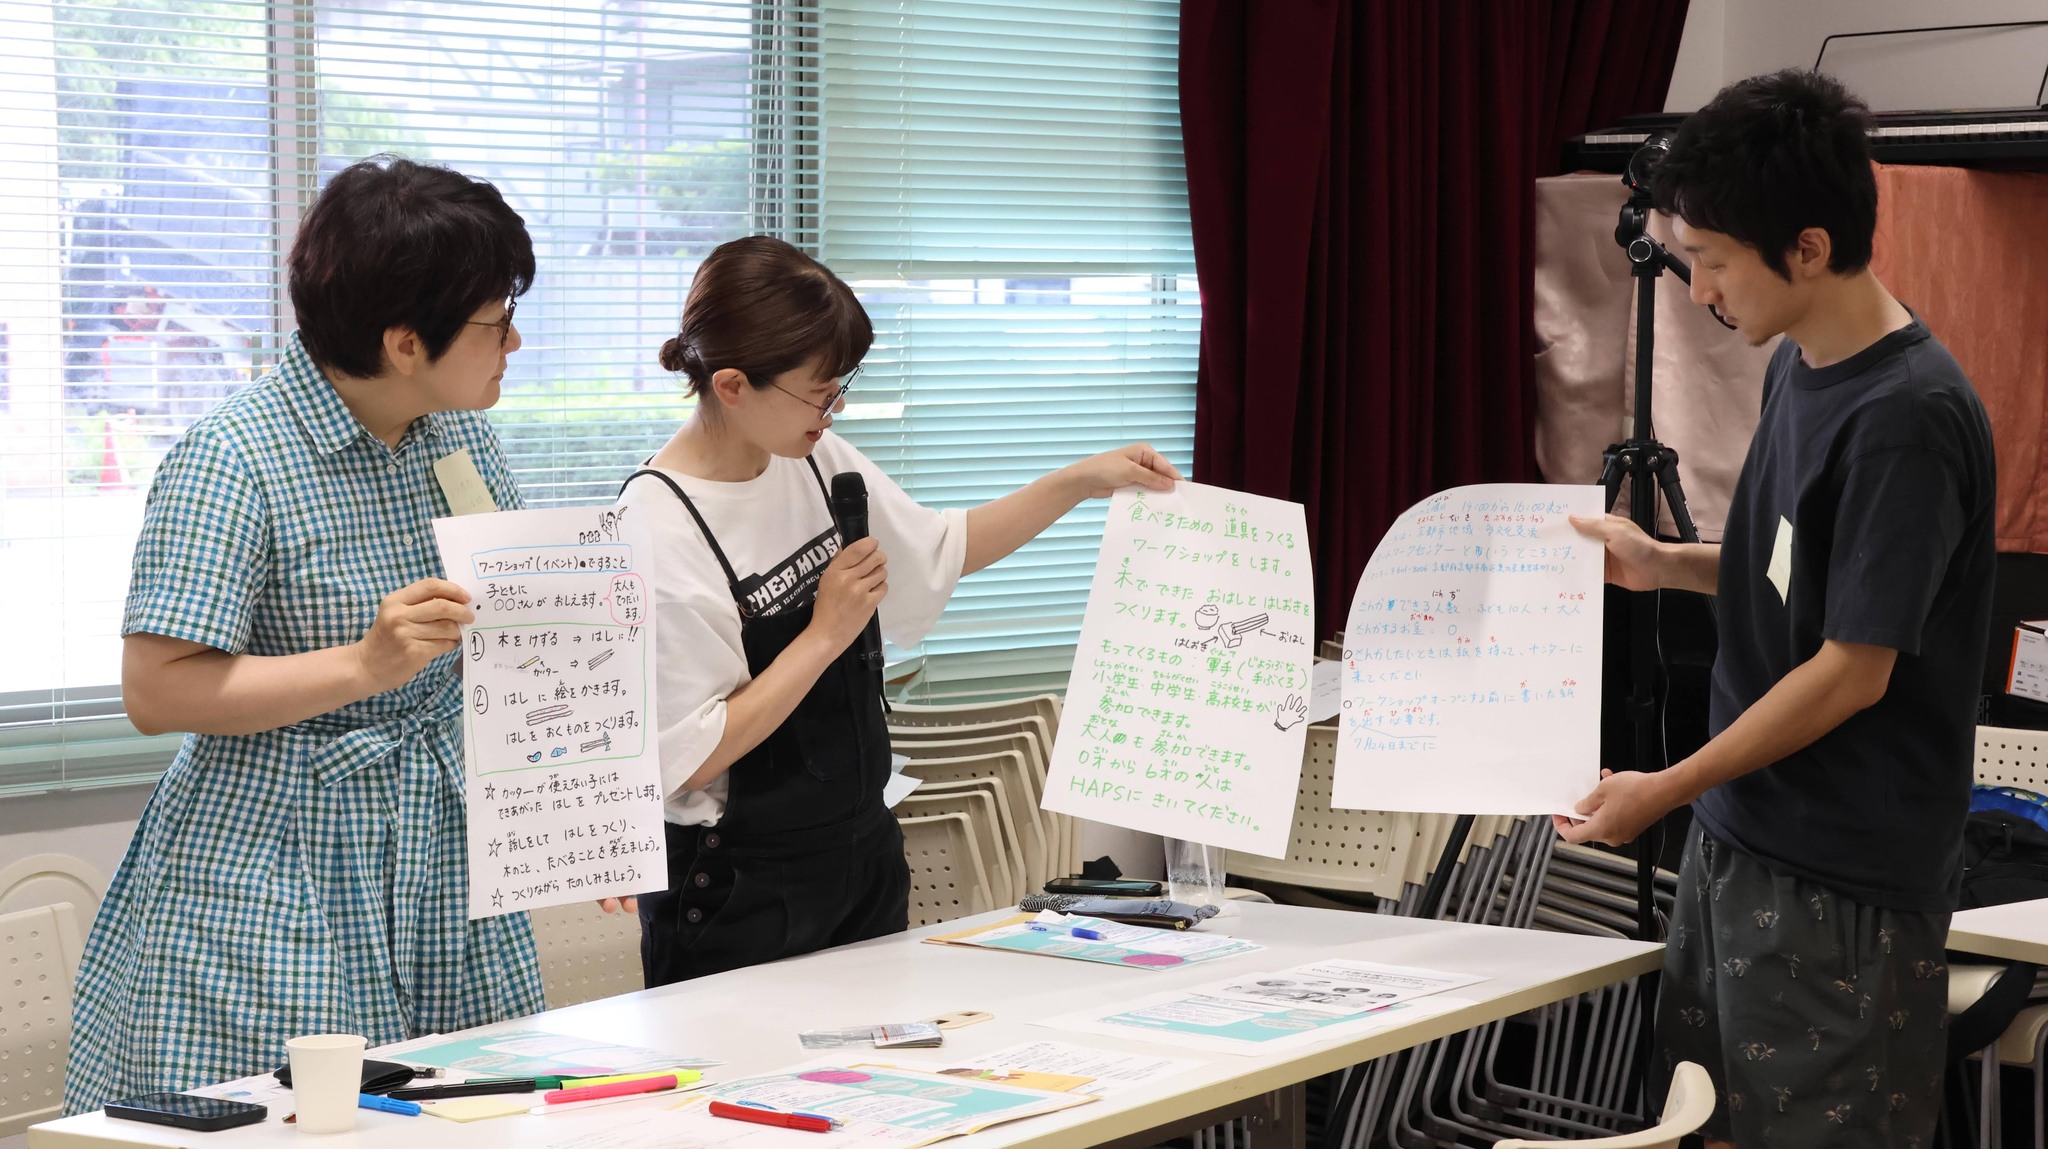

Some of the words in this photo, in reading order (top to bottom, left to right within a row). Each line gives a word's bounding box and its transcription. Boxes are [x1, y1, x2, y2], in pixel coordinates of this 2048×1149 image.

[1127, 500, 1214, 534] 食べるための
[1133, 538, 1241, 569] ワークショップを
[1249, 558, 1292, 578] します。
[486, 583, 528, 598] 子どもに
[614, 580, 635, 592] 大人も
[615, 593, 639, 606] てつだい
[1113, 601, 1187, 629] つくります。
[1174, 638, 1209, 652] はしおき
[497, 801, 543, 820] できあがった
[1151, 793, 1261, 831] きいてください。
[511, 884, 560, 902] つくりながら
